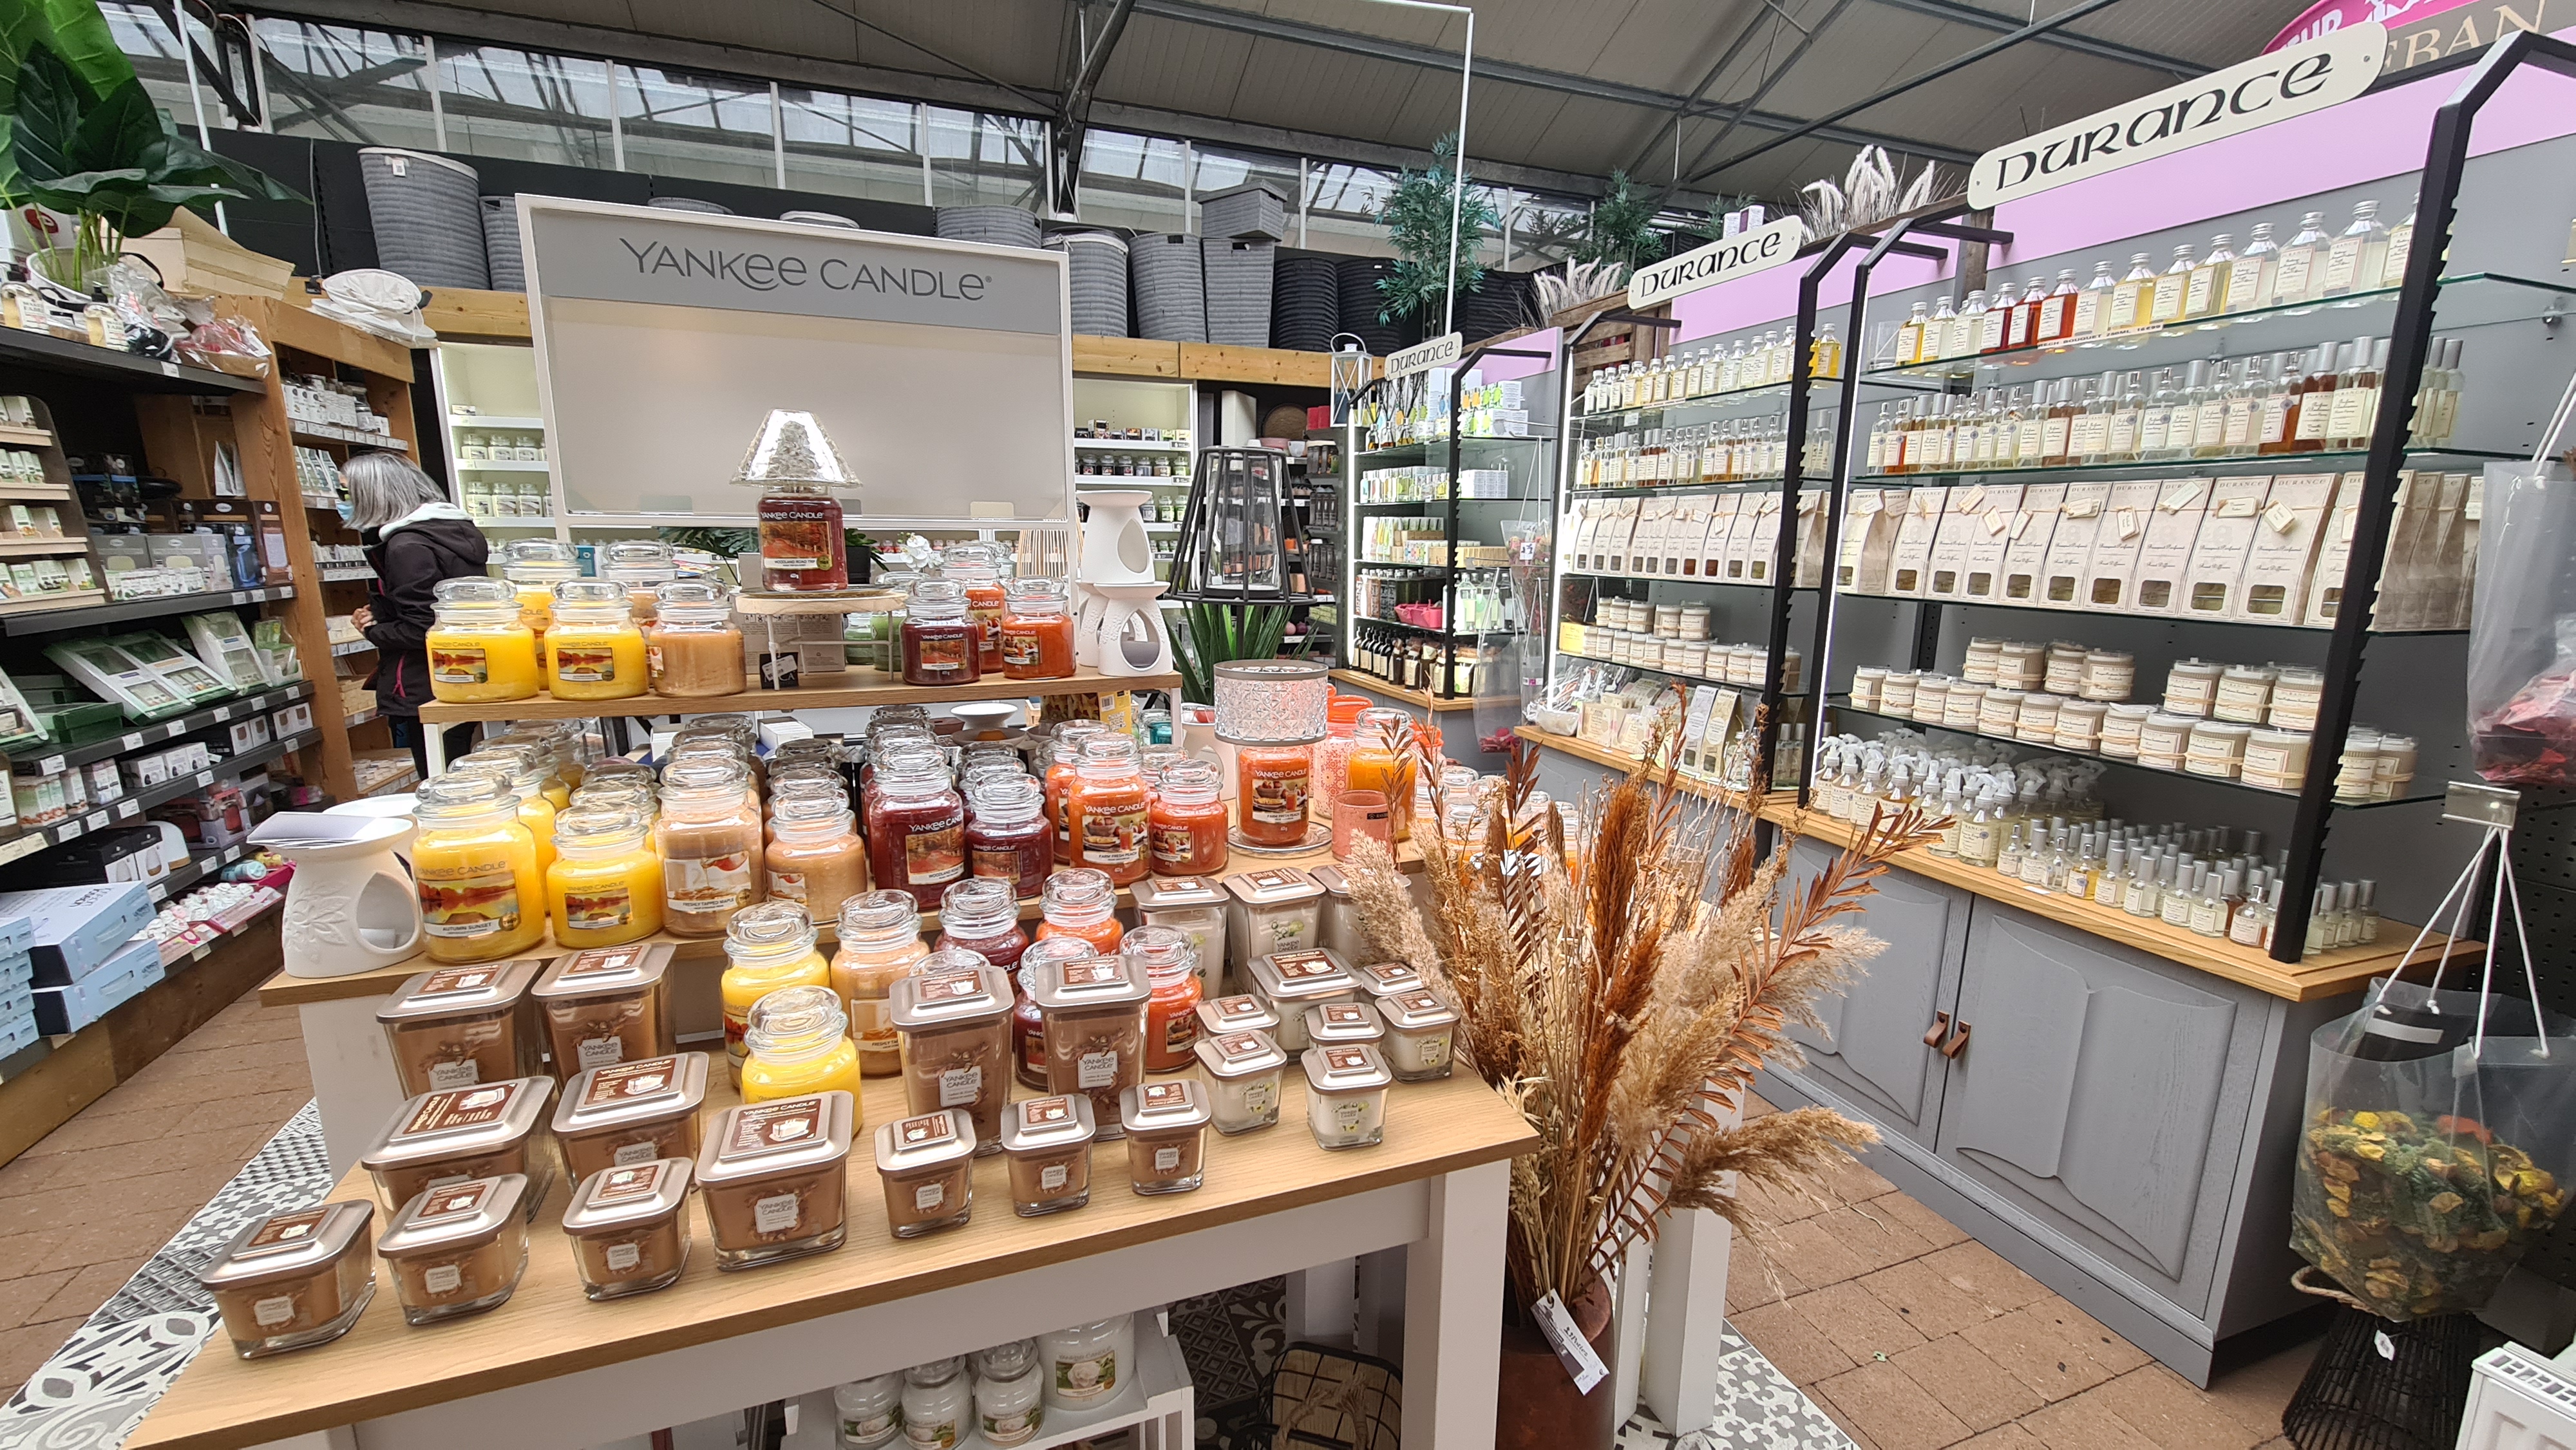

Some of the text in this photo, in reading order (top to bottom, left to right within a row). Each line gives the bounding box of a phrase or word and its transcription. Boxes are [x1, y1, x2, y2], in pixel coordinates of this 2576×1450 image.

[1996, 52, 2331, 191] DURANCE
[1640, 231, 1781, 297] DURANCE
[2063, 334, 2101, 343] BOUQUET
[1390, 340, 1454, 371] DURANCE
[946, 814, 962, 825] CAND
[1083, 1057, 1114, 1065] YANKEE
[944, 1072, 978, 1082] YANKEE
[946, 1078, 977, 1088] CANDLE
